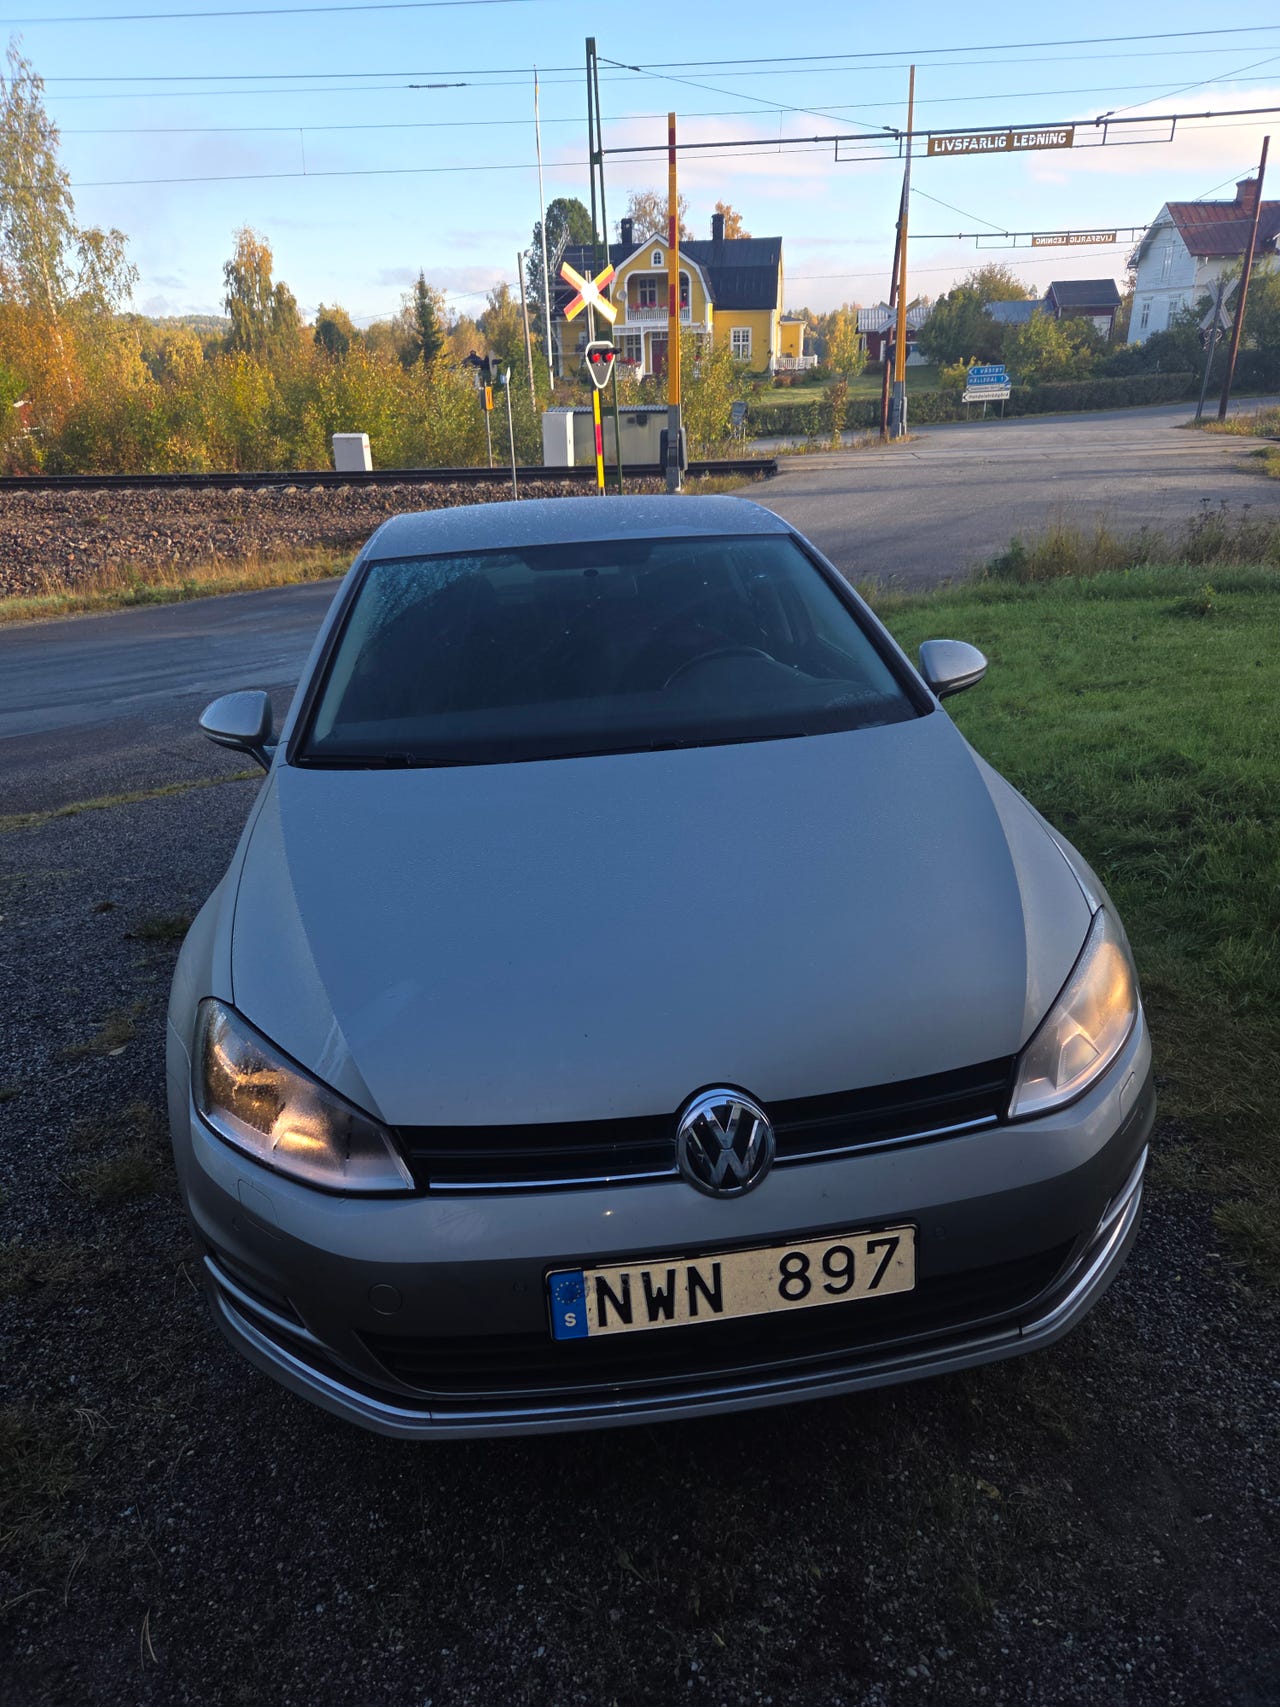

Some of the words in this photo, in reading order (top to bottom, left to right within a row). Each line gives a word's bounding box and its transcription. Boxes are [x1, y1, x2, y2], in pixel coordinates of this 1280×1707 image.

[934, 136, 1007, 152] LIVSFARLIG
[1013, 132, 1067, 147] LEDNING
[595, 1262, 723, 1327] NWN
[778, 1236, 900, 1301] 897
[564, 1313, 577, 1327] S
